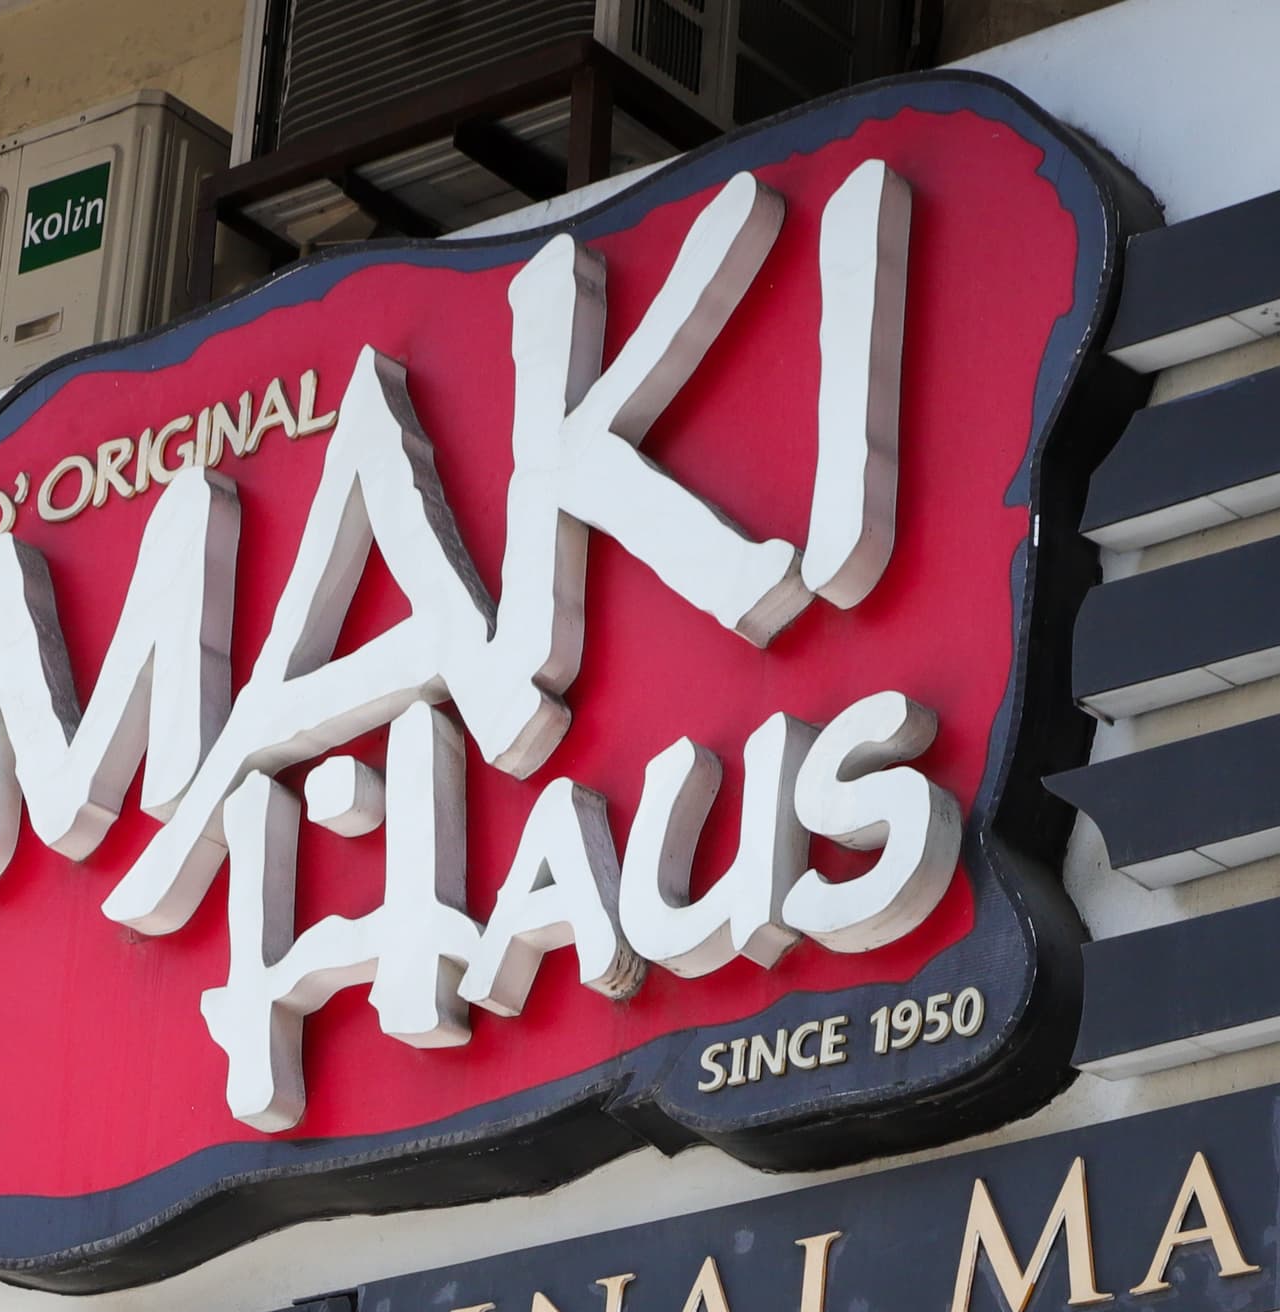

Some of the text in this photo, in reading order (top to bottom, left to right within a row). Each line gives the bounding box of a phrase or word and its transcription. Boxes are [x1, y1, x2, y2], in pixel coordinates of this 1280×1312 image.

[23, 195, 104, 249] kolin
[201, 690, 962, 1134] HAUS
[698, 986, 984, 1092] SINCE 1950
